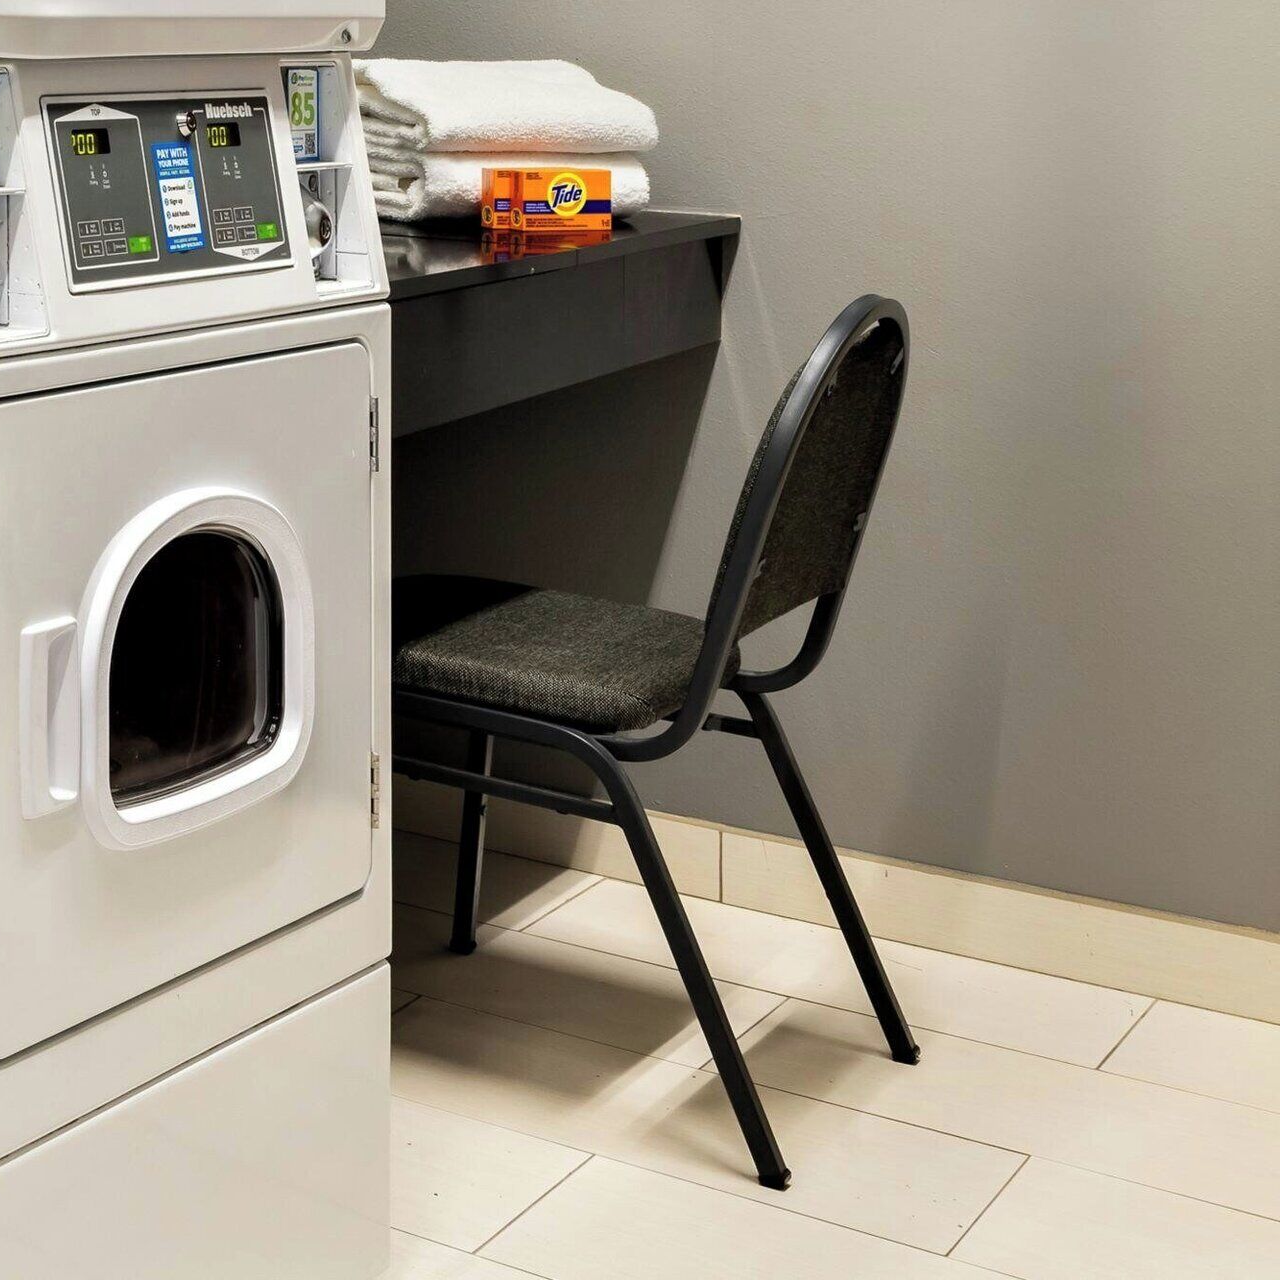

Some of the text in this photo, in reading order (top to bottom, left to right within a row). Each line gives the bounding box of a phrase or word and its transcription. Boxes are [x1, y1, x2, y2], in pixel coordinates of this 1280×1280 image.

[90, 108, 101, 116] TOP
[205, 102, 253, 119] Huebsch
[291, 91, 315, 126] 85
[156, 147, 188, 159] PAY WITH
[551, 184, 582, 209] Tide
